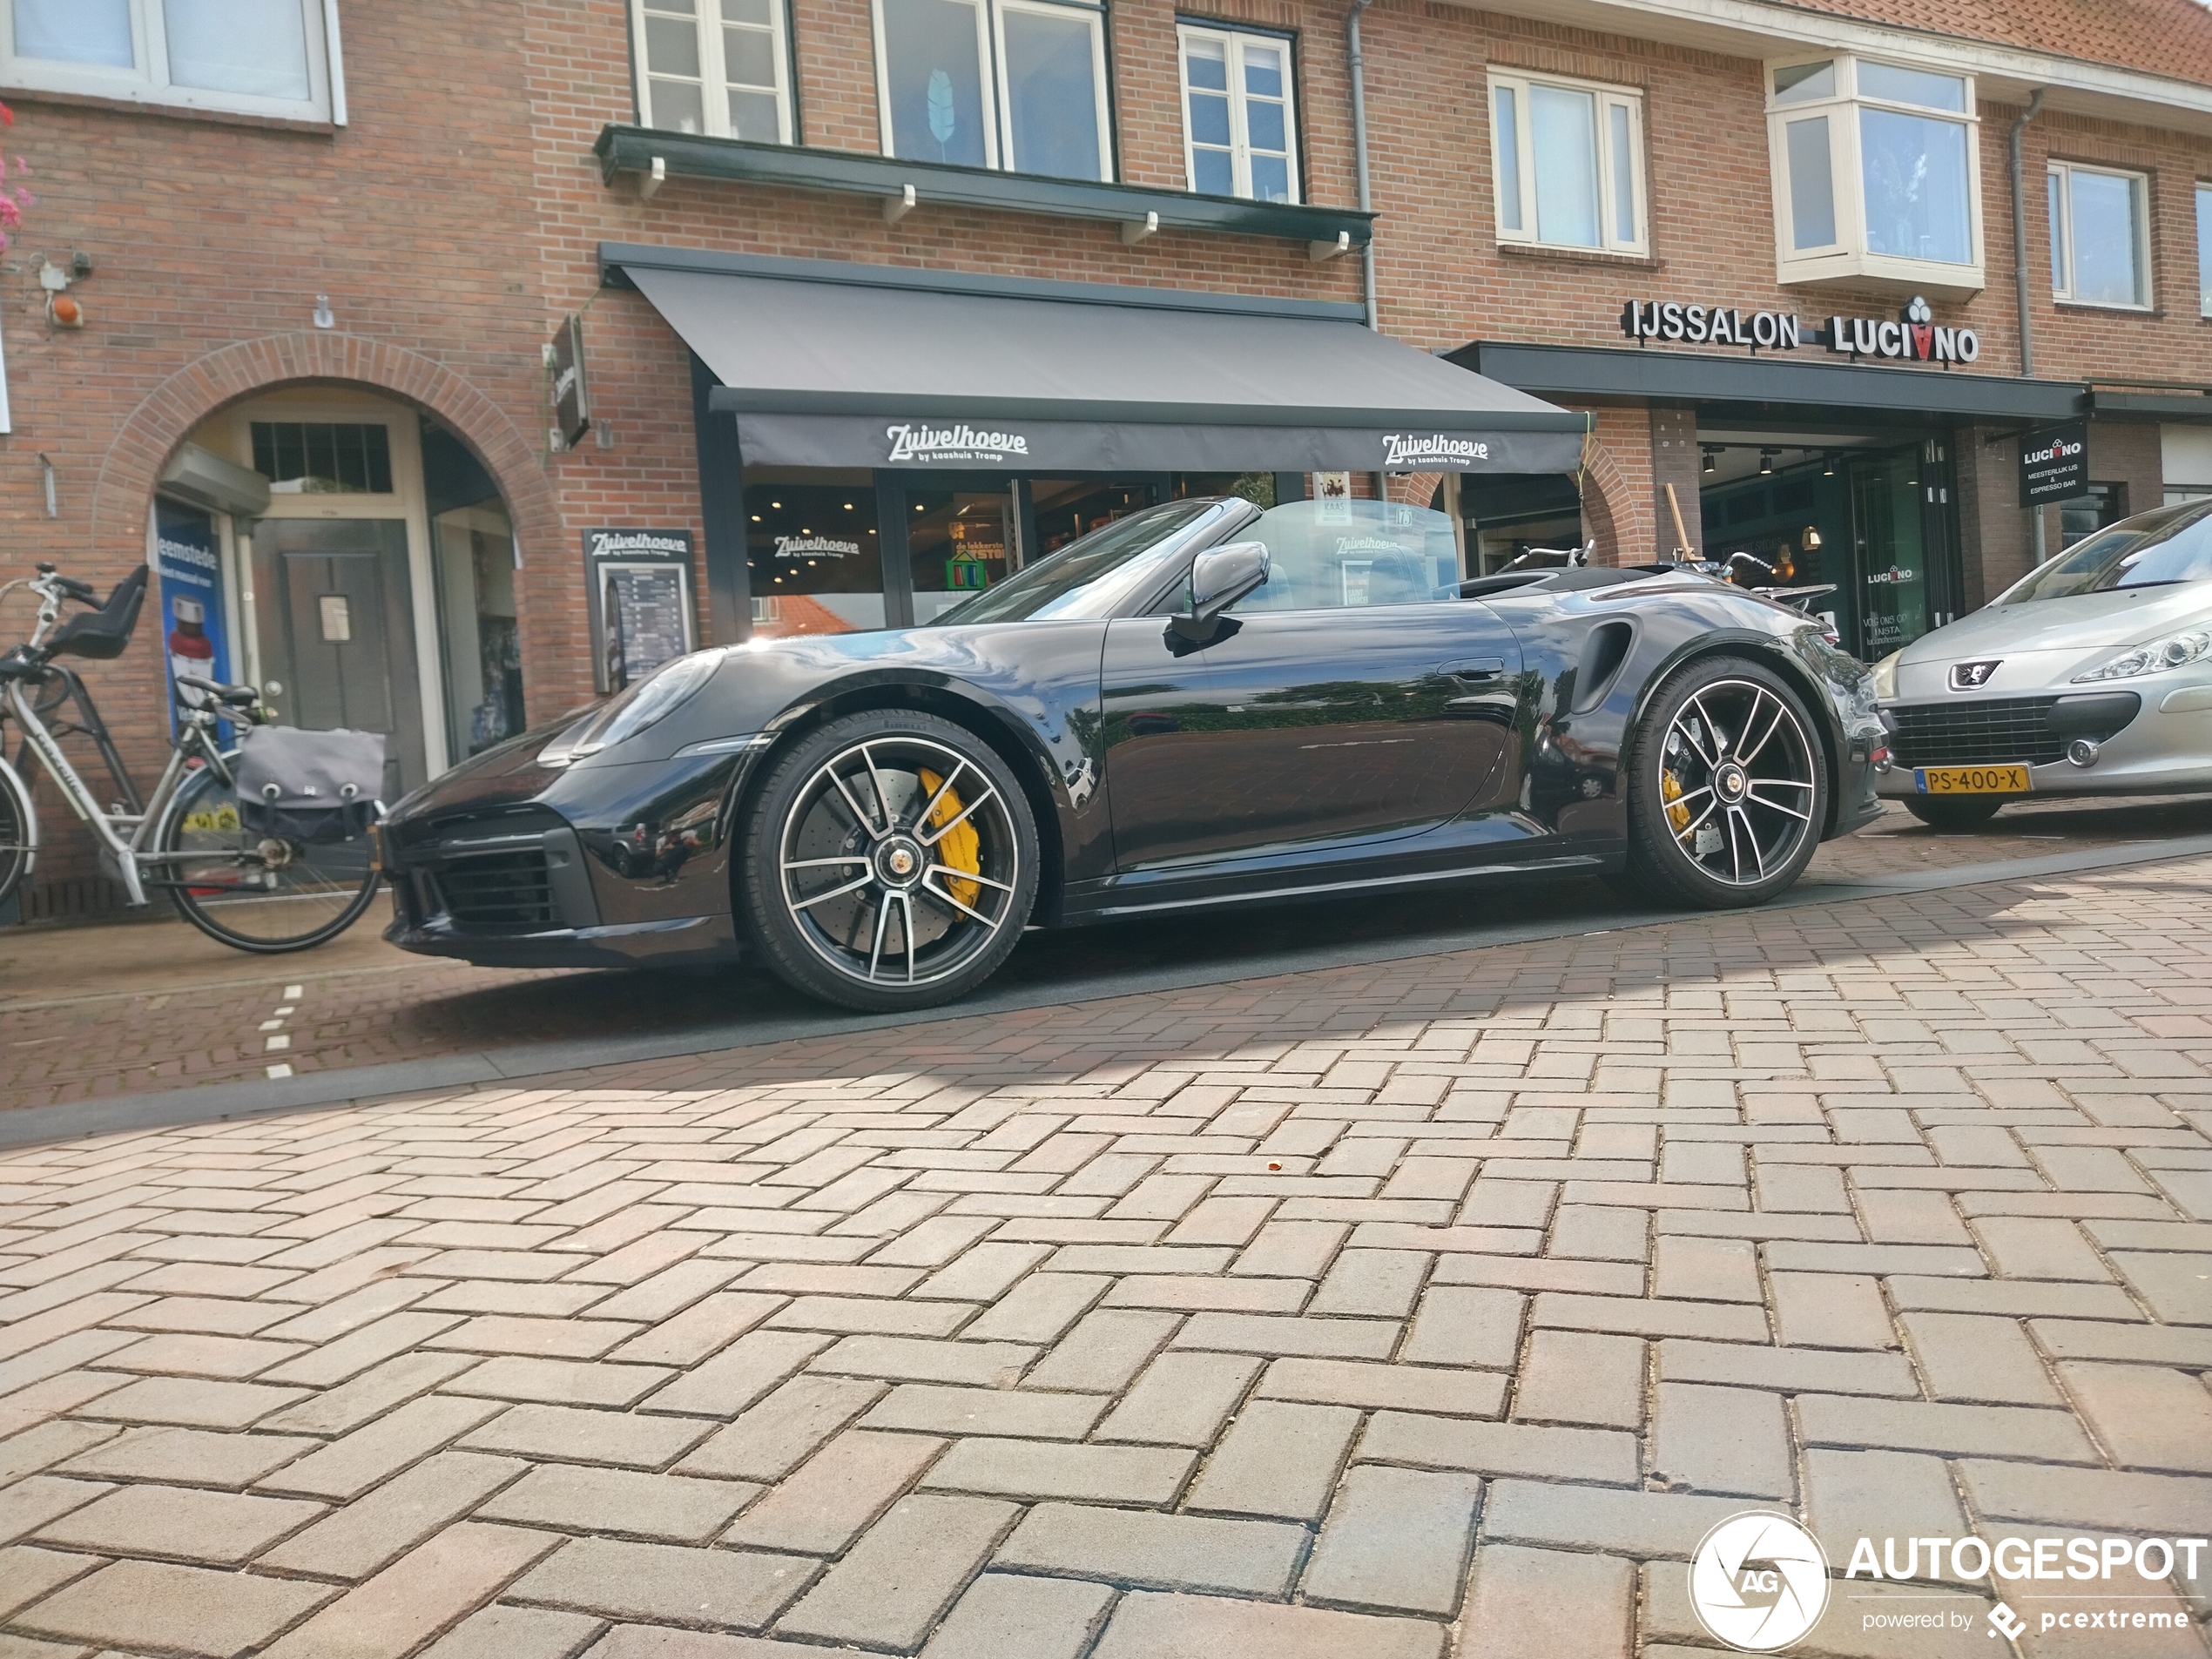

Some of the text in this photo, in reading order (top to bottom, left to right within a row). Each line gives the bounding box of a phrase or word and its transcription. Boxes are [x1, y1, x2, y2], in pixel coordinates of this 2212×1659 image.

[1632, 300, 1979, 362] IJSSALON LUCIANO
[887, 424, 1028, 462] Zuivelhoeve
[1382, 434, 1488, 465] Zuivelhoeve
[918, 451, 1003, 462] by kaashuis Tromp
[1407, 457, 1416, 466] by
[1449, 456, 1471, 466] Tromp
[2024, 442, 2081, 465] LUCIANO
[2027, 466, 2067, 480] MEESTERLIJK
[2030, 482, 2062, 495] ESPRESSO
[1324, 502, 1345, 511] KAAS
[1397, 509, 1412, 525] 175
[591, 533, 687, 556] Zuivelhoeve
[774, 536, 860, 557] Zuivelhoeve
[968, 541, 1004, 550] lekkerste
[1337, 536, 1398, 555] Zuivelhoeve
[1868, 569, 1912, 584] LUCIANO
[1863, 613, 1907, 628] VOLG ONS OP
[1874, 626, 1901, 636] INSTA
[1928, 769, 2020, 790] PS-400-X
[954, 824, 968, 867] ORSCHE
